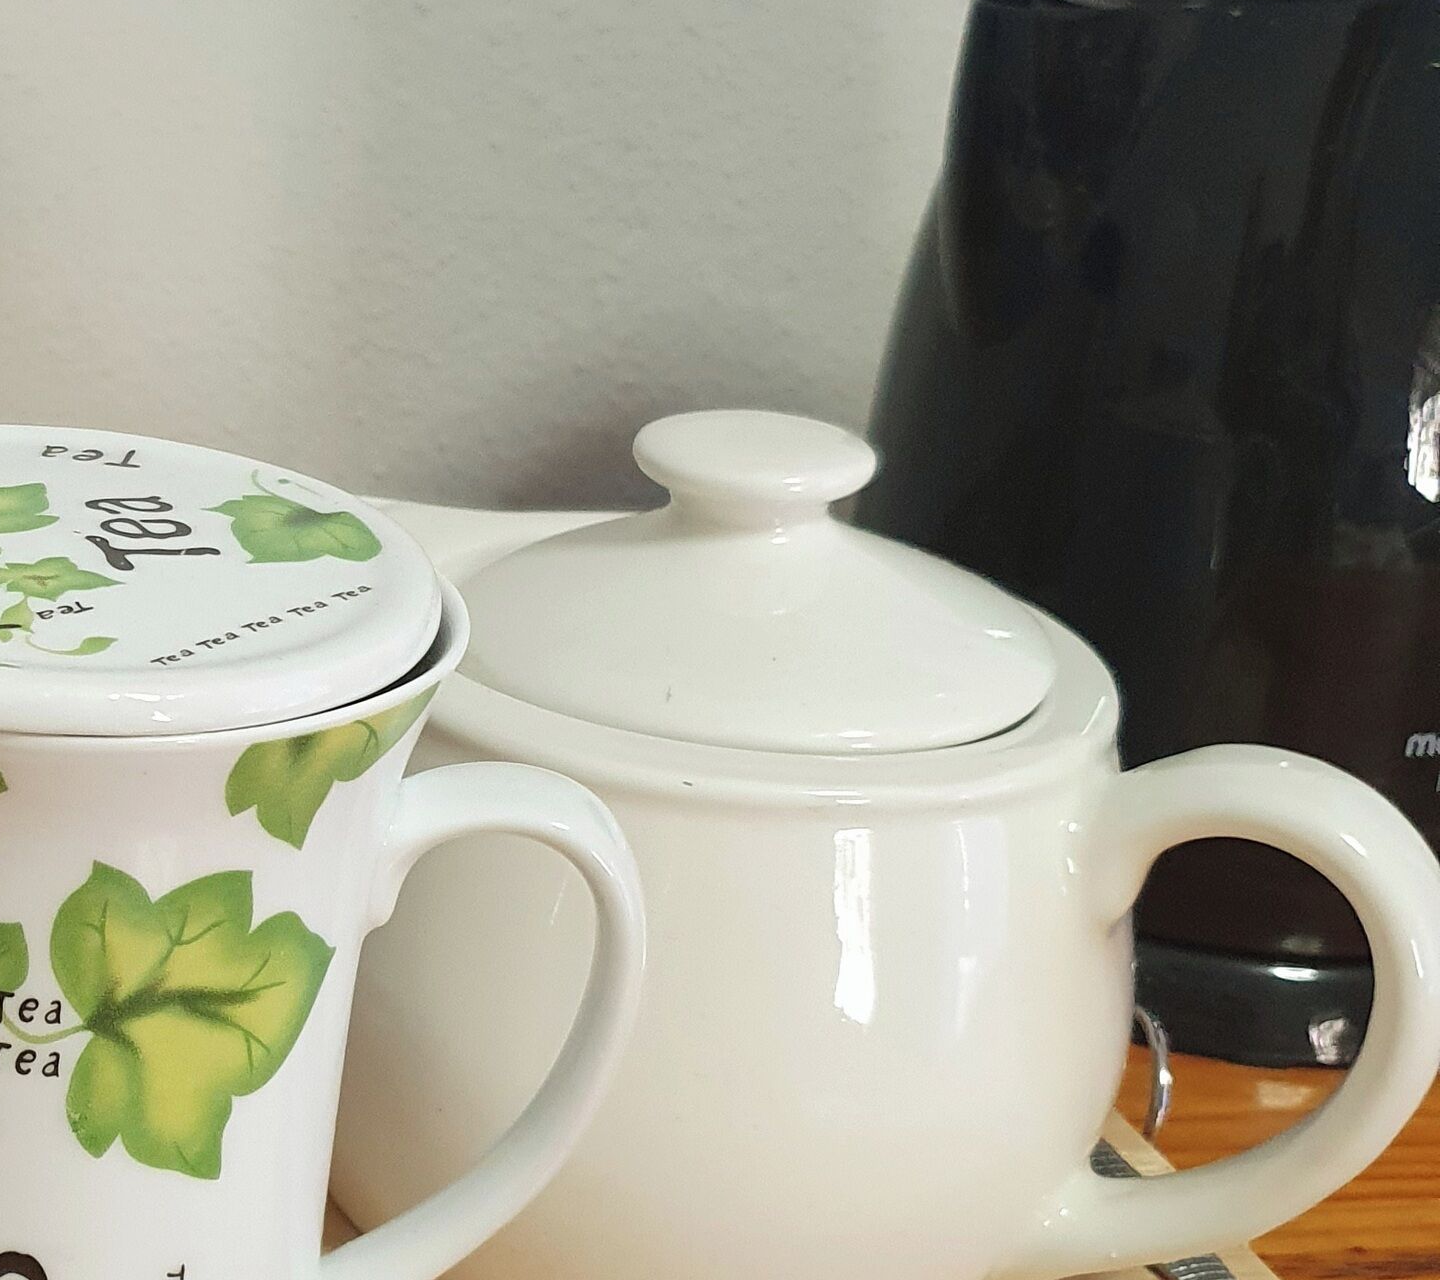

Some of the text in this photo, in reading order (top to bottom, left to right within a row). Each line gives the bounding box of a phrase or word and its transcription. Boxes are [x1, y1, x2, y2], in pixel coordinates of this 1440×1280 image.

[41, 444, 140, 469] Tea
[84, 495, 221, 571] Tea
[36, 600, 94, 621] Tea
[150, 584, 373, 667] Tea Tea Tea Tea Tea
